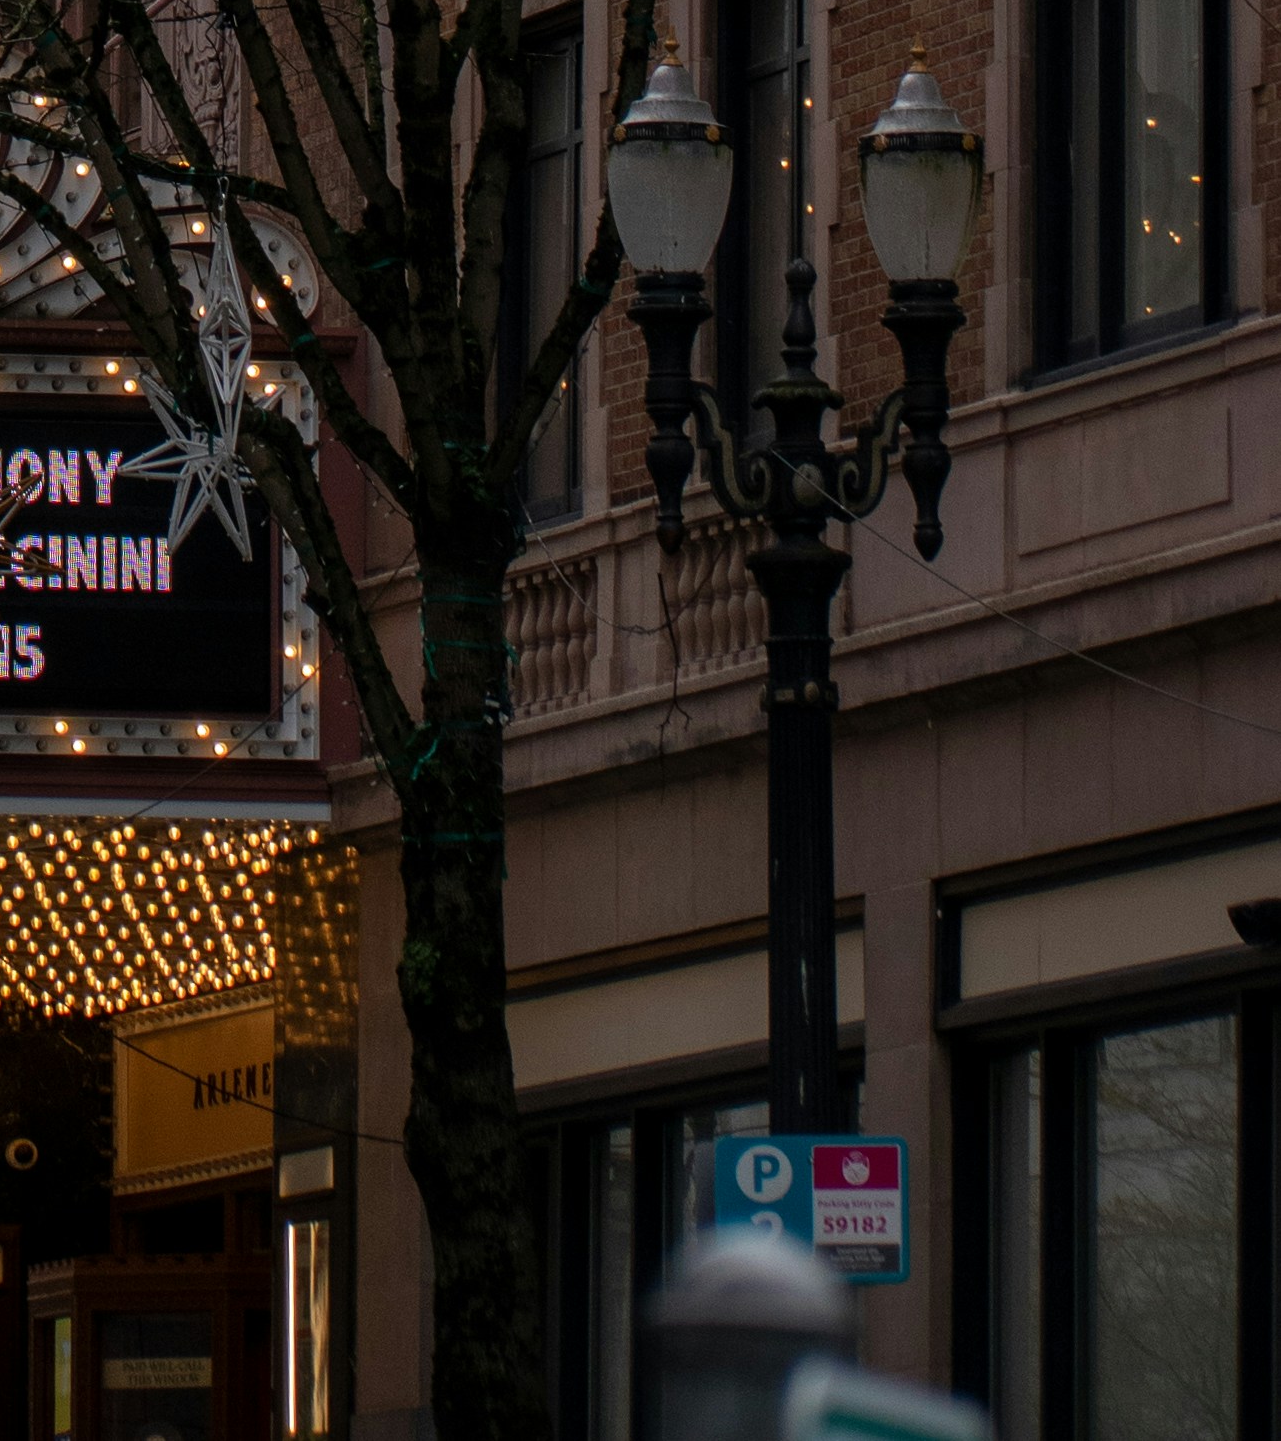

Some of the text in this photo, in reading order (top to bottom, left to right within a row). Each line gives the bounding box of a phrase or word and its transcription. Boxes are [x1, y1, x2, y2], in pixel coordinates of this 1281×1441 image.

[194, 1062, 271, 1109] ARLENE
[753, 1154, 780, 1193] P
[823, 1215, 887, 1234] 59182
